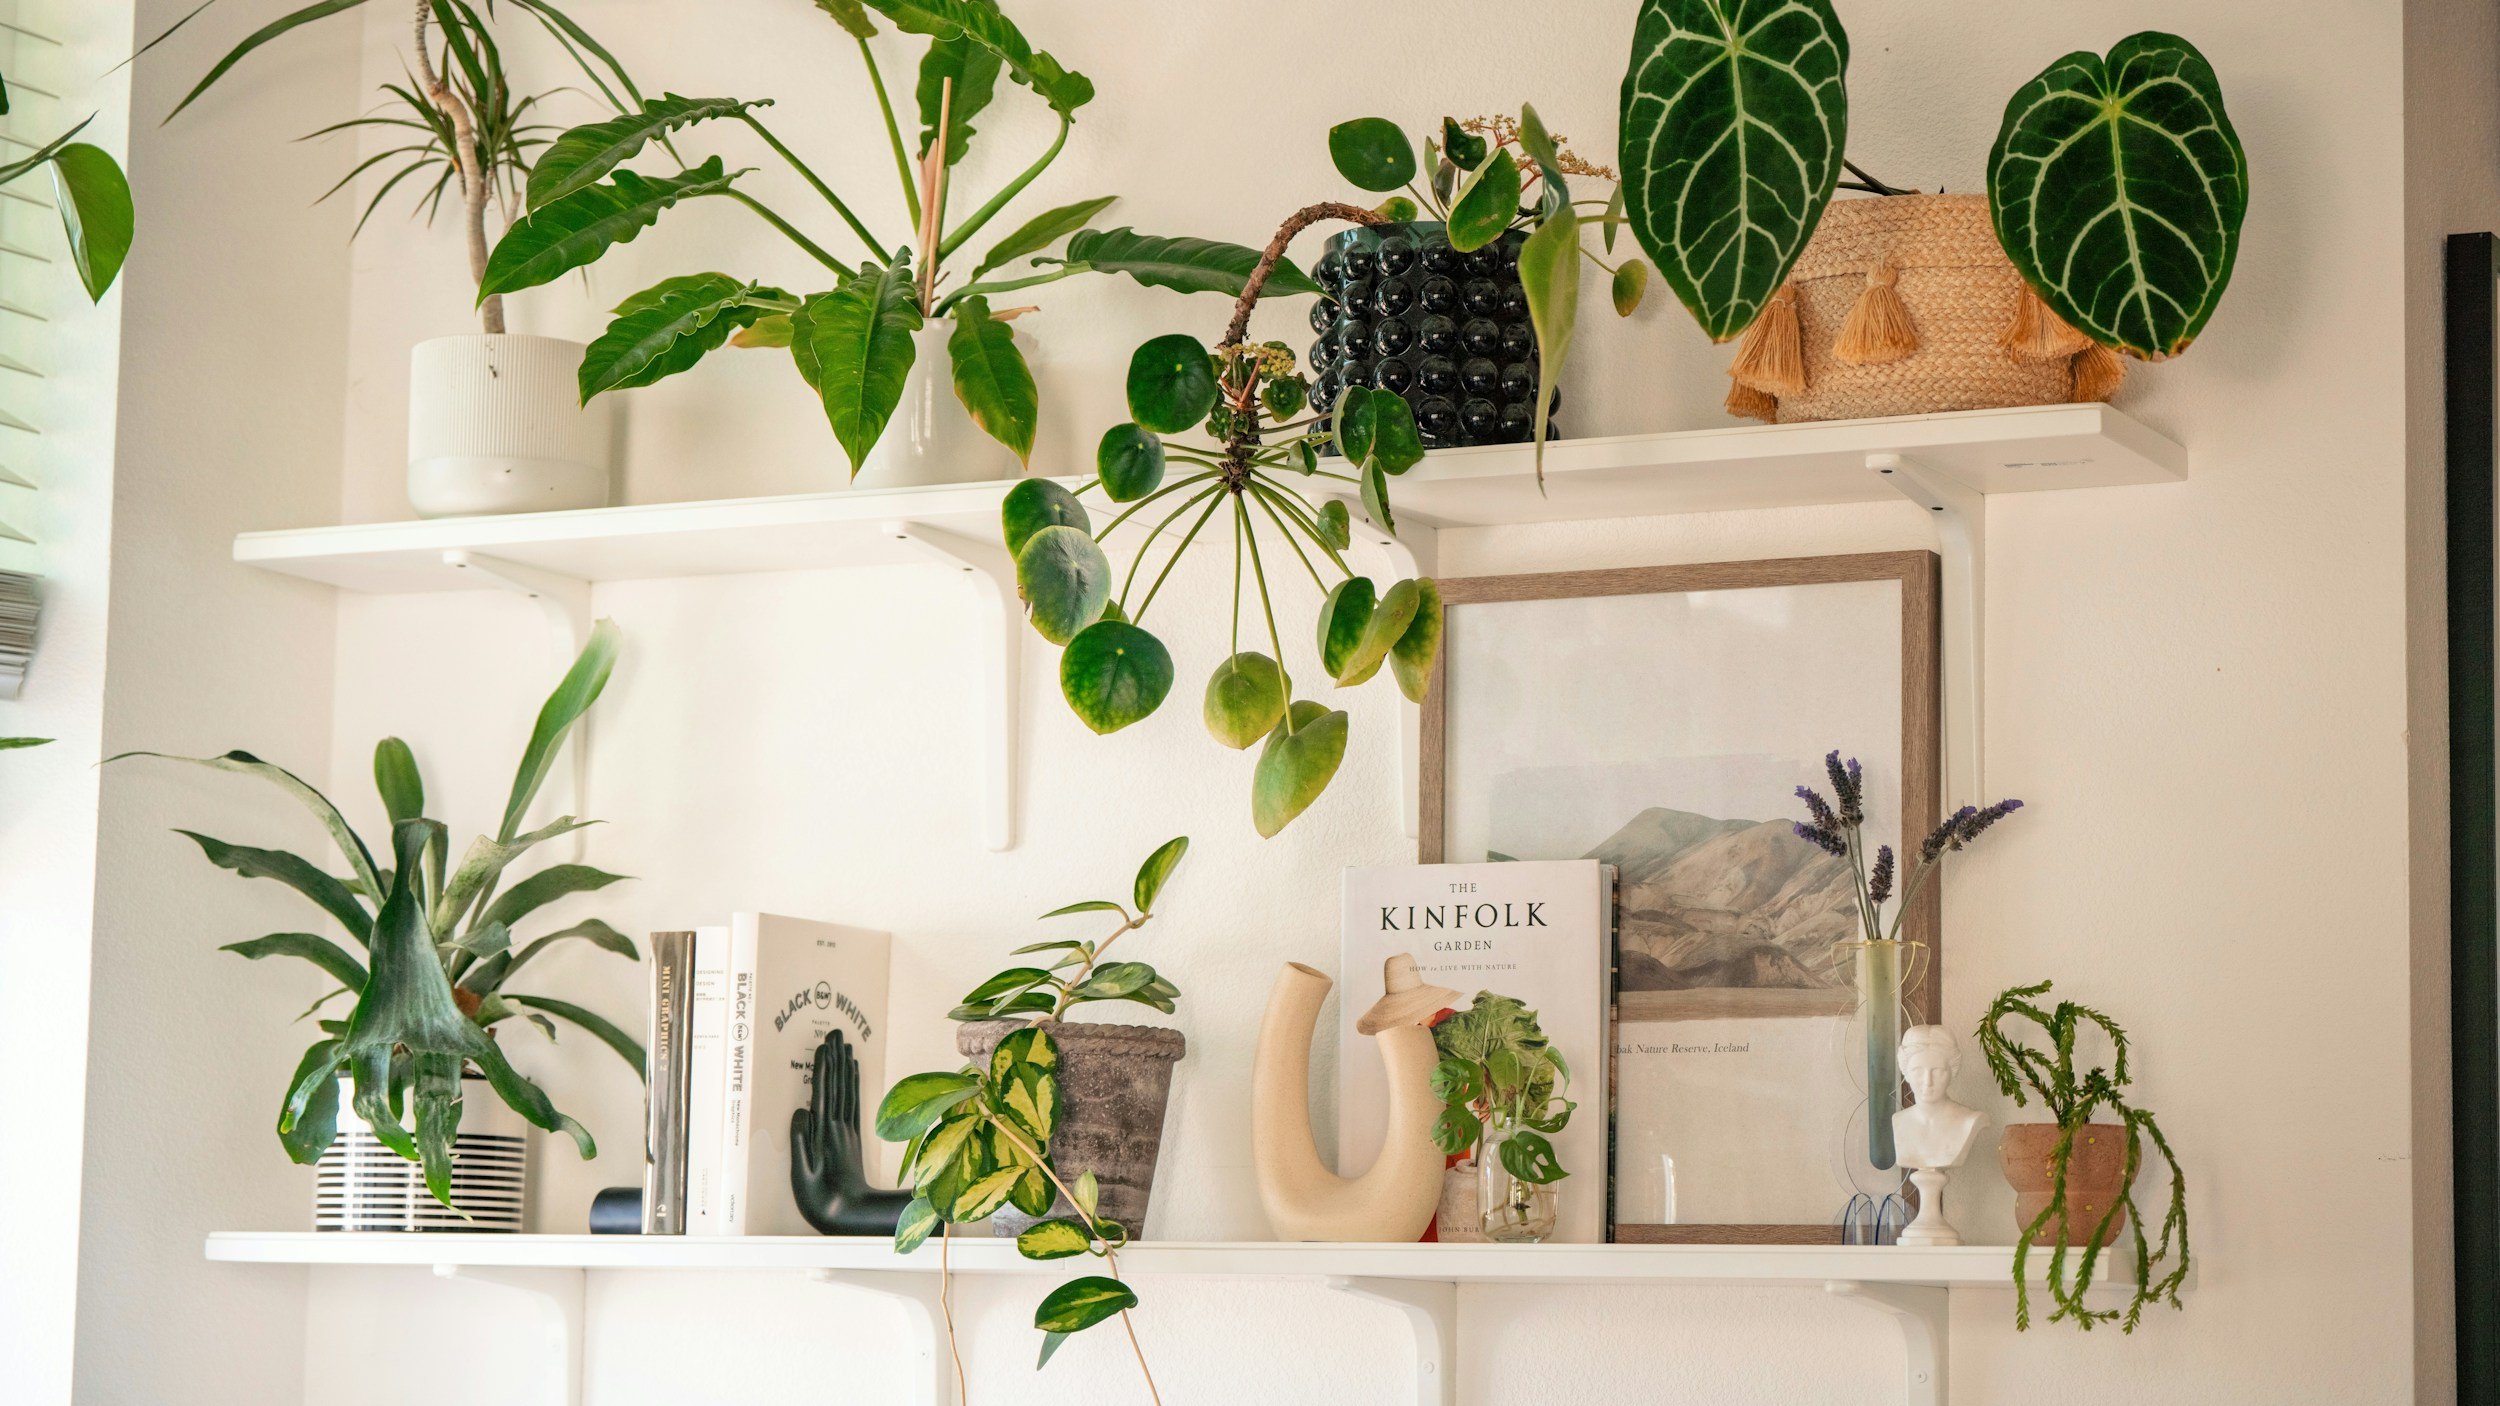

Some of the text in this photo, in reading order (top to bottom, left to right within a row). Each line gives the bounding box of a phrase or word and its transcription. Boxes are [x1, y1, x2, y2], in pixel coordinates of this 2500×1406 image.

[1449, 882, 1478, 894] THE
[1380, 901, 1548, 931] KINFOLK
[1433, 939, 1493, 952] GARDEN
[1440, 964, 1458, 972] LIVE
[1485, 963, 1517, 971] NATURE
[735, 973, 747, 1020] BLACK
[658, 965, 671, 1072] MINI GRAPHICS 2
[774, 988, 872, 1042] BLACK B&W WHITE
[1636, 1044, 1668, 1054] Nature
[1671, 1043, 1711, 1054] Reserve,
[1714, 1043, 1750, 1053] Iceland
[732, 1045, 744, 1092] WHITE
[790, 1060, 804, 1070] New
